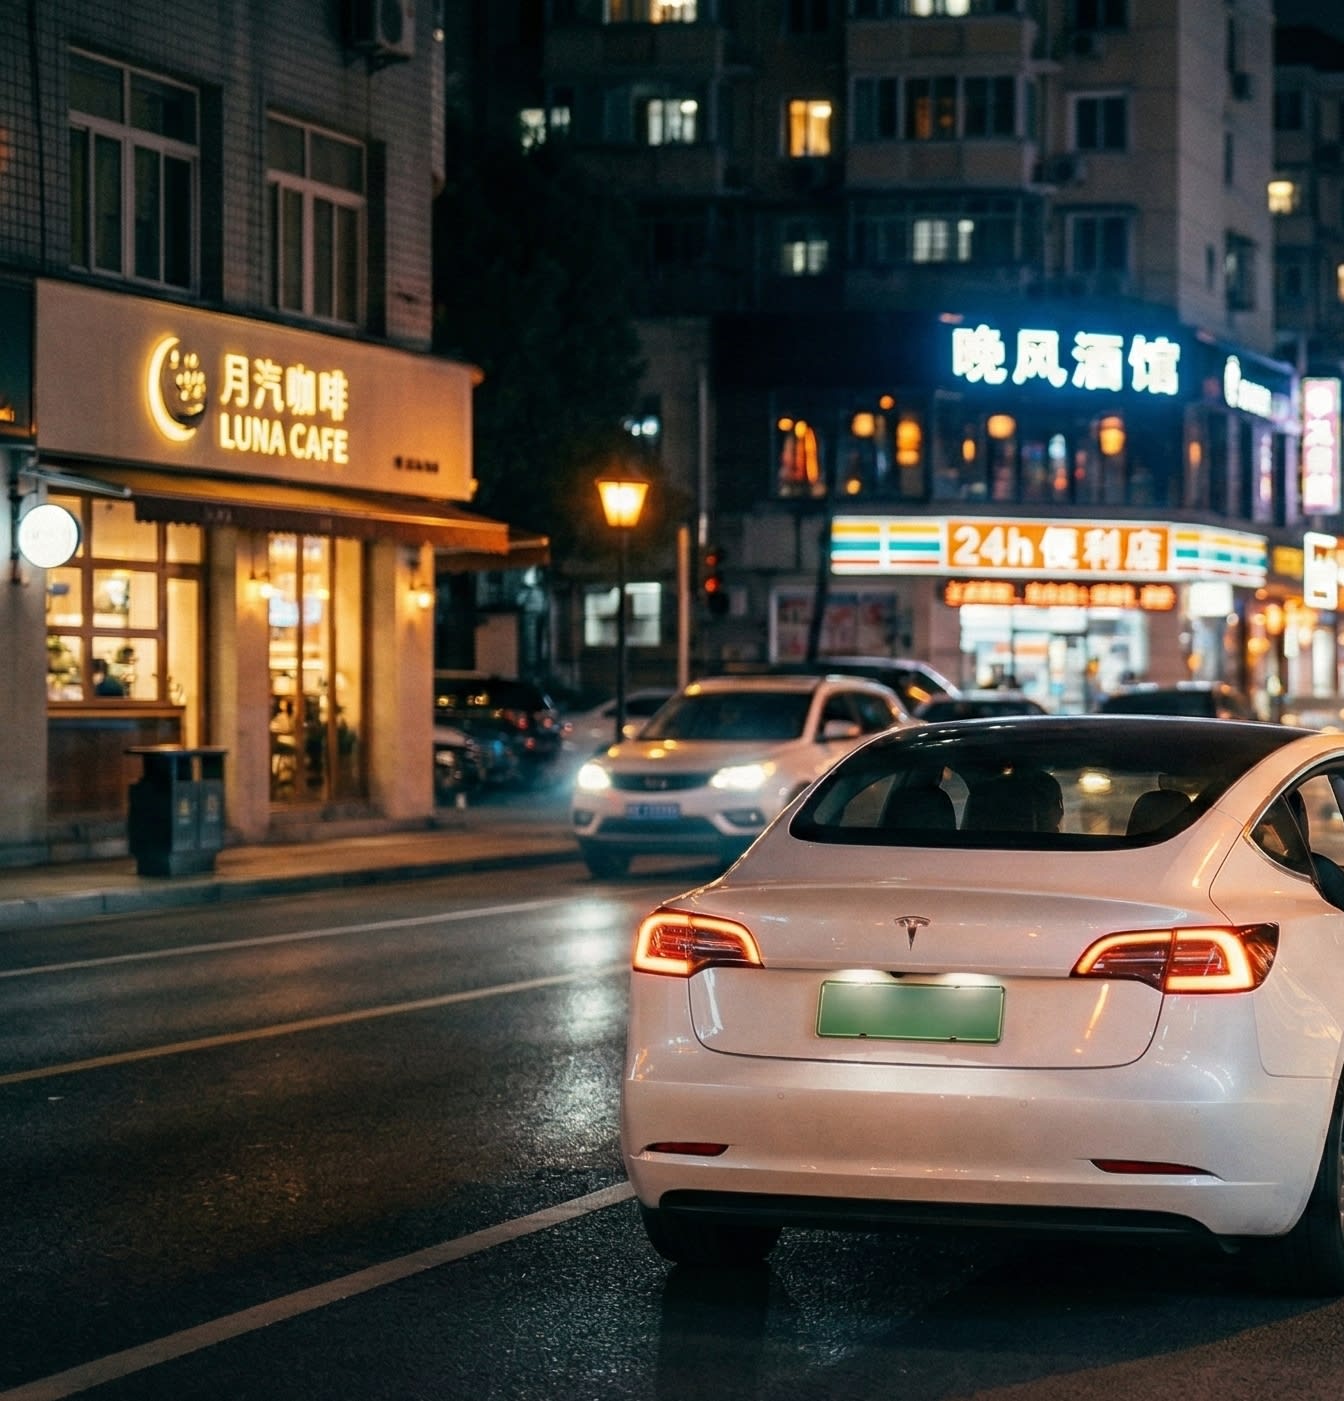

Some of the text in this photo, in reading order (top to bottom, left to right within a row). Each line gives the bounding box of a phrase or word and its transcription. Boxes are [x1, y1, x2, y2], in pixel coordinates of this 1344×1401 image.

[951, 324, 1181, 396] 晚风酒馆
[219, 412, 348, 464] LUNA CAFE
